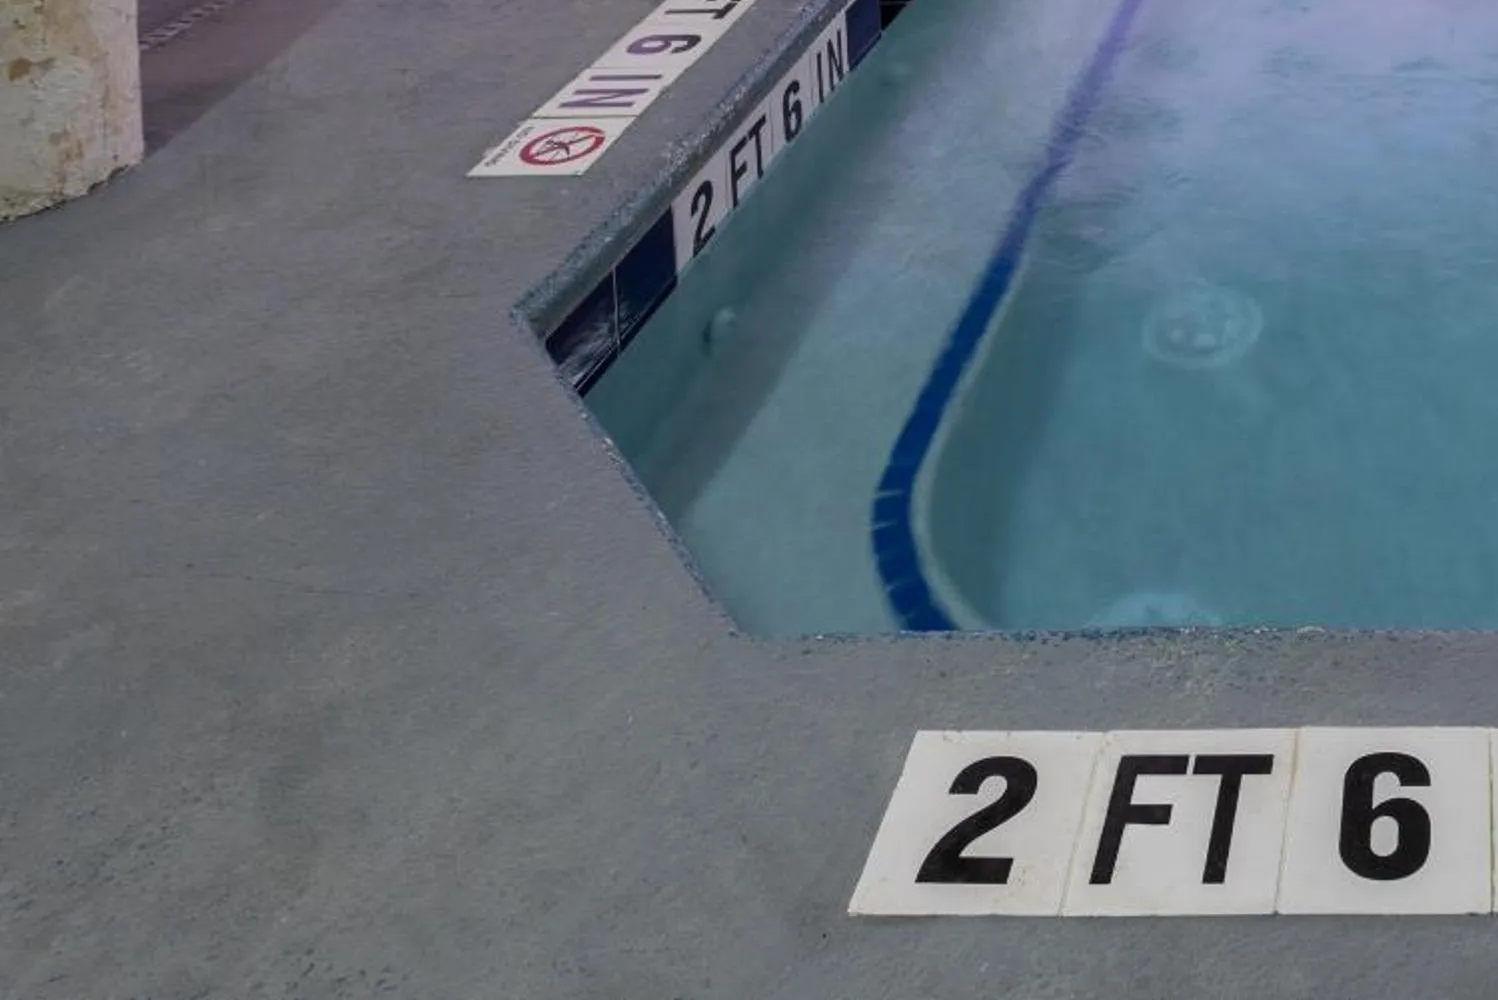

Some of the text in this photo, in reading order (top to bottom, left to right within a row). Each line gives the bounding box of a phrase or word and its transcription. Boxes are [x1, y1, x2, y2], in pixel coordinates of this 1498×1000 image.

[625, 33, 703, 56] 6
[557, 72, 664, 111] IN
[690, 28, 844, 257] 2 FT 6 IN
[914, 754, 1039, 885] 2
[1088, 752, 1274, 885] FT
[1337, 750, 1432, 882] 6
